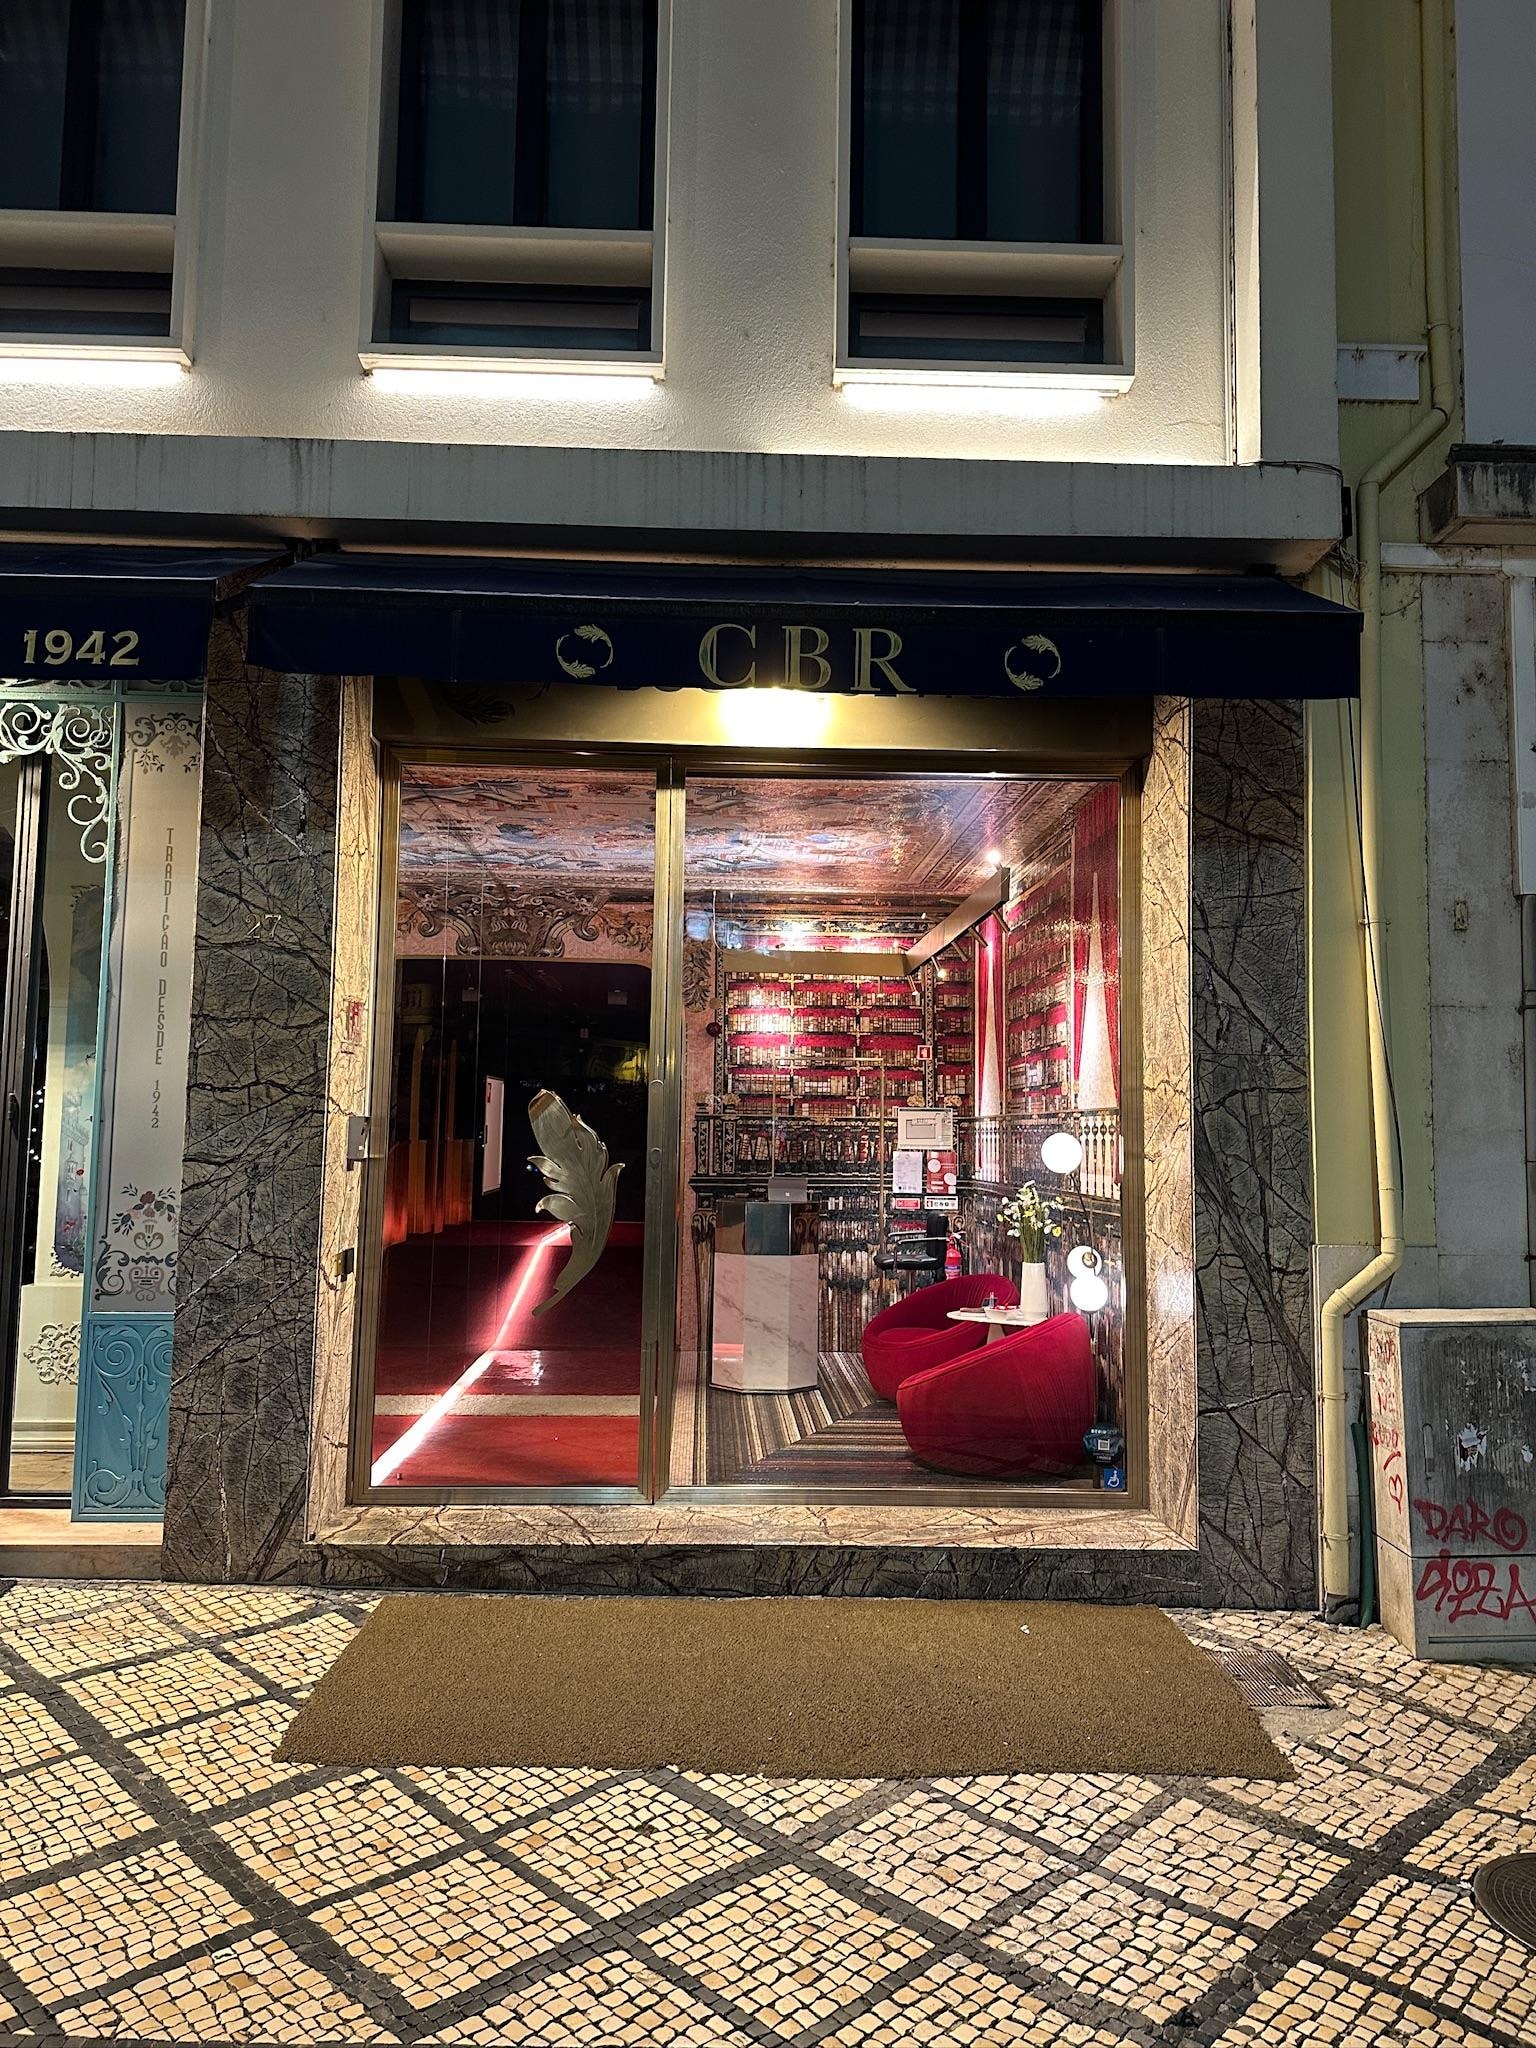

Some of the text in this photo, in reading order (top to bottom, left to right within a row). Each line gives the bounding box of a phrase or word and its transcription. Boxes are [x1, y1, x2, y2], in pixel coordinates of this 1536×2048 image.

[23, 629, 140, 667] 1942
[699, 622, 917, 692] CBR
[245, 913, 282, 939] 27
[155, 978, 167, 1065] DESDE
[151, 1079, 161, 1129] 1942
